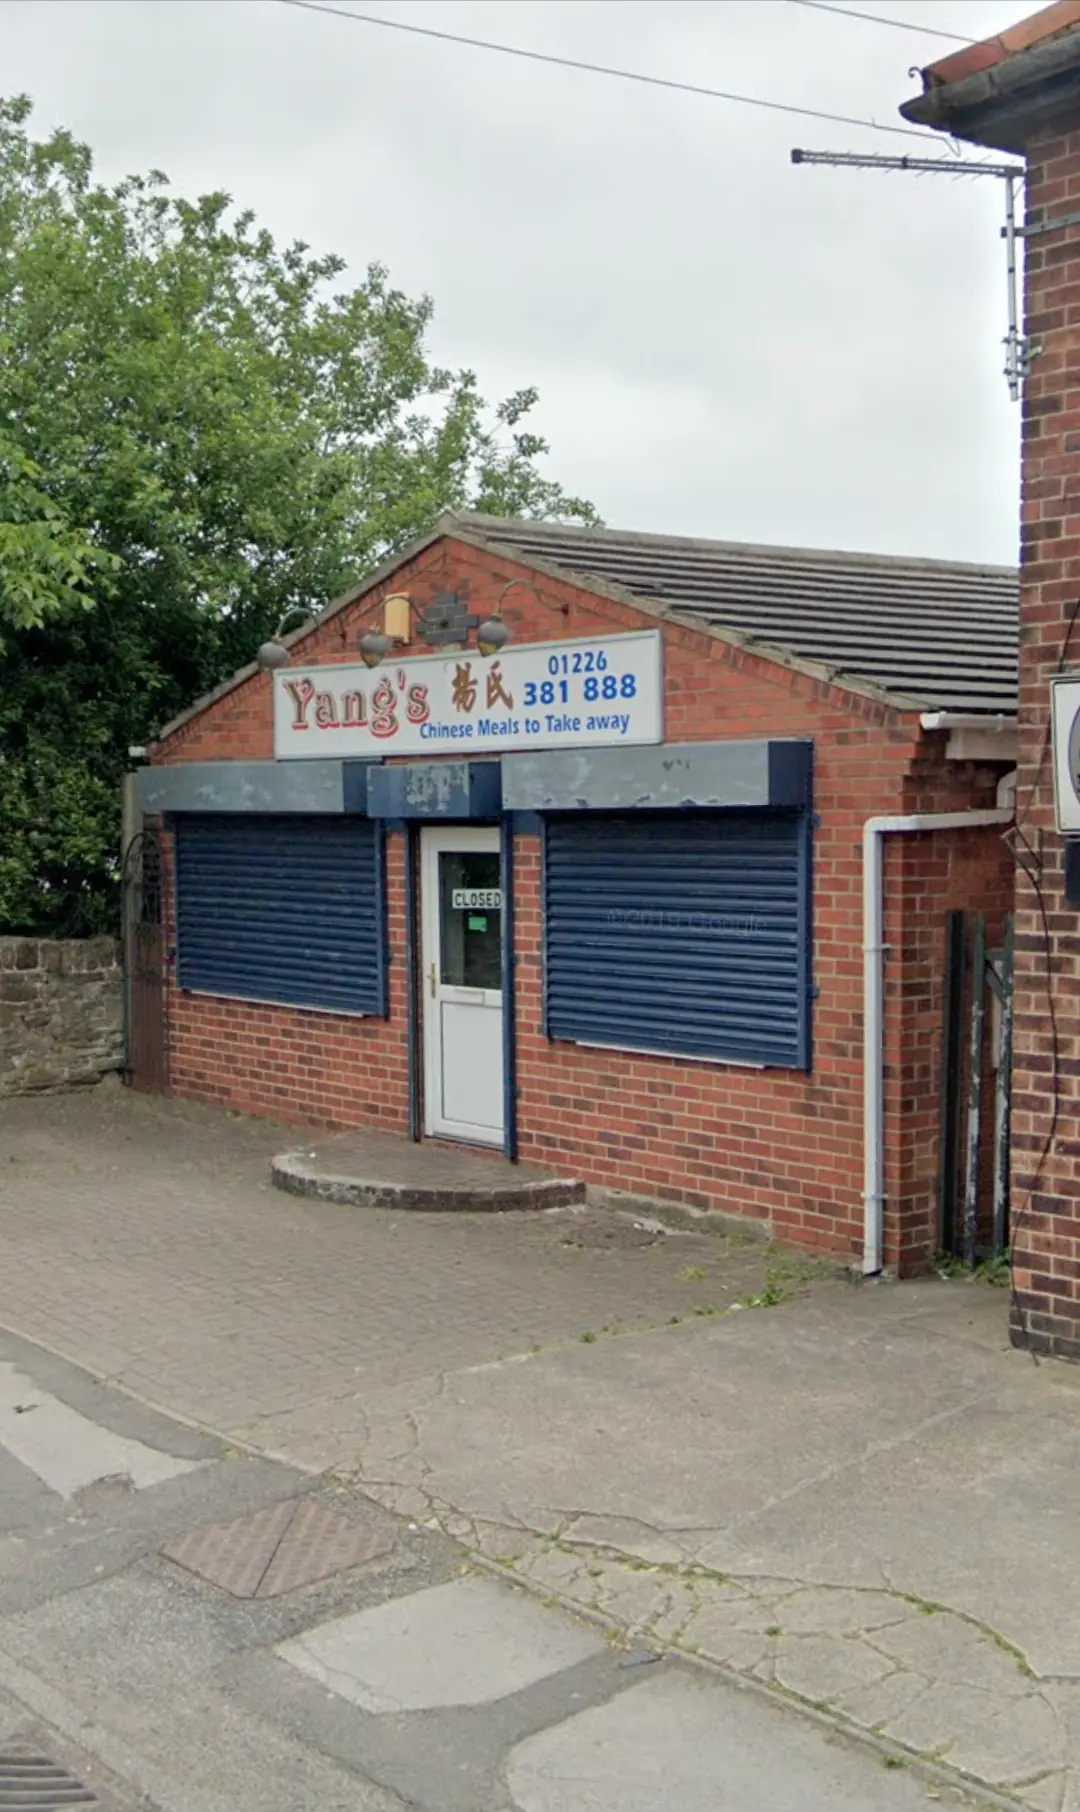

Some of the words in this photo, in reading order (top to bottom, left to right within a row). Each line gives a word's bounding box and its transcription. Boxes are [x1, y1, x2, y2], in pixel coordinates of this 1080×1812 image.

[547, 650, 608, 676] 01226
[523, 681, 570, 706] 381
[583, 673, 637, 701] 888
[282, 669, 430, 738] Yang's
[419, 722, 474, 740] Chinese
[477, 718, 520, 737] Meals
[524, 718, 541, 735] to
[545, 713, 582, 733] Take
[585, 713, 631, 735] away
[454, 892, 501, 907] CLOSED
